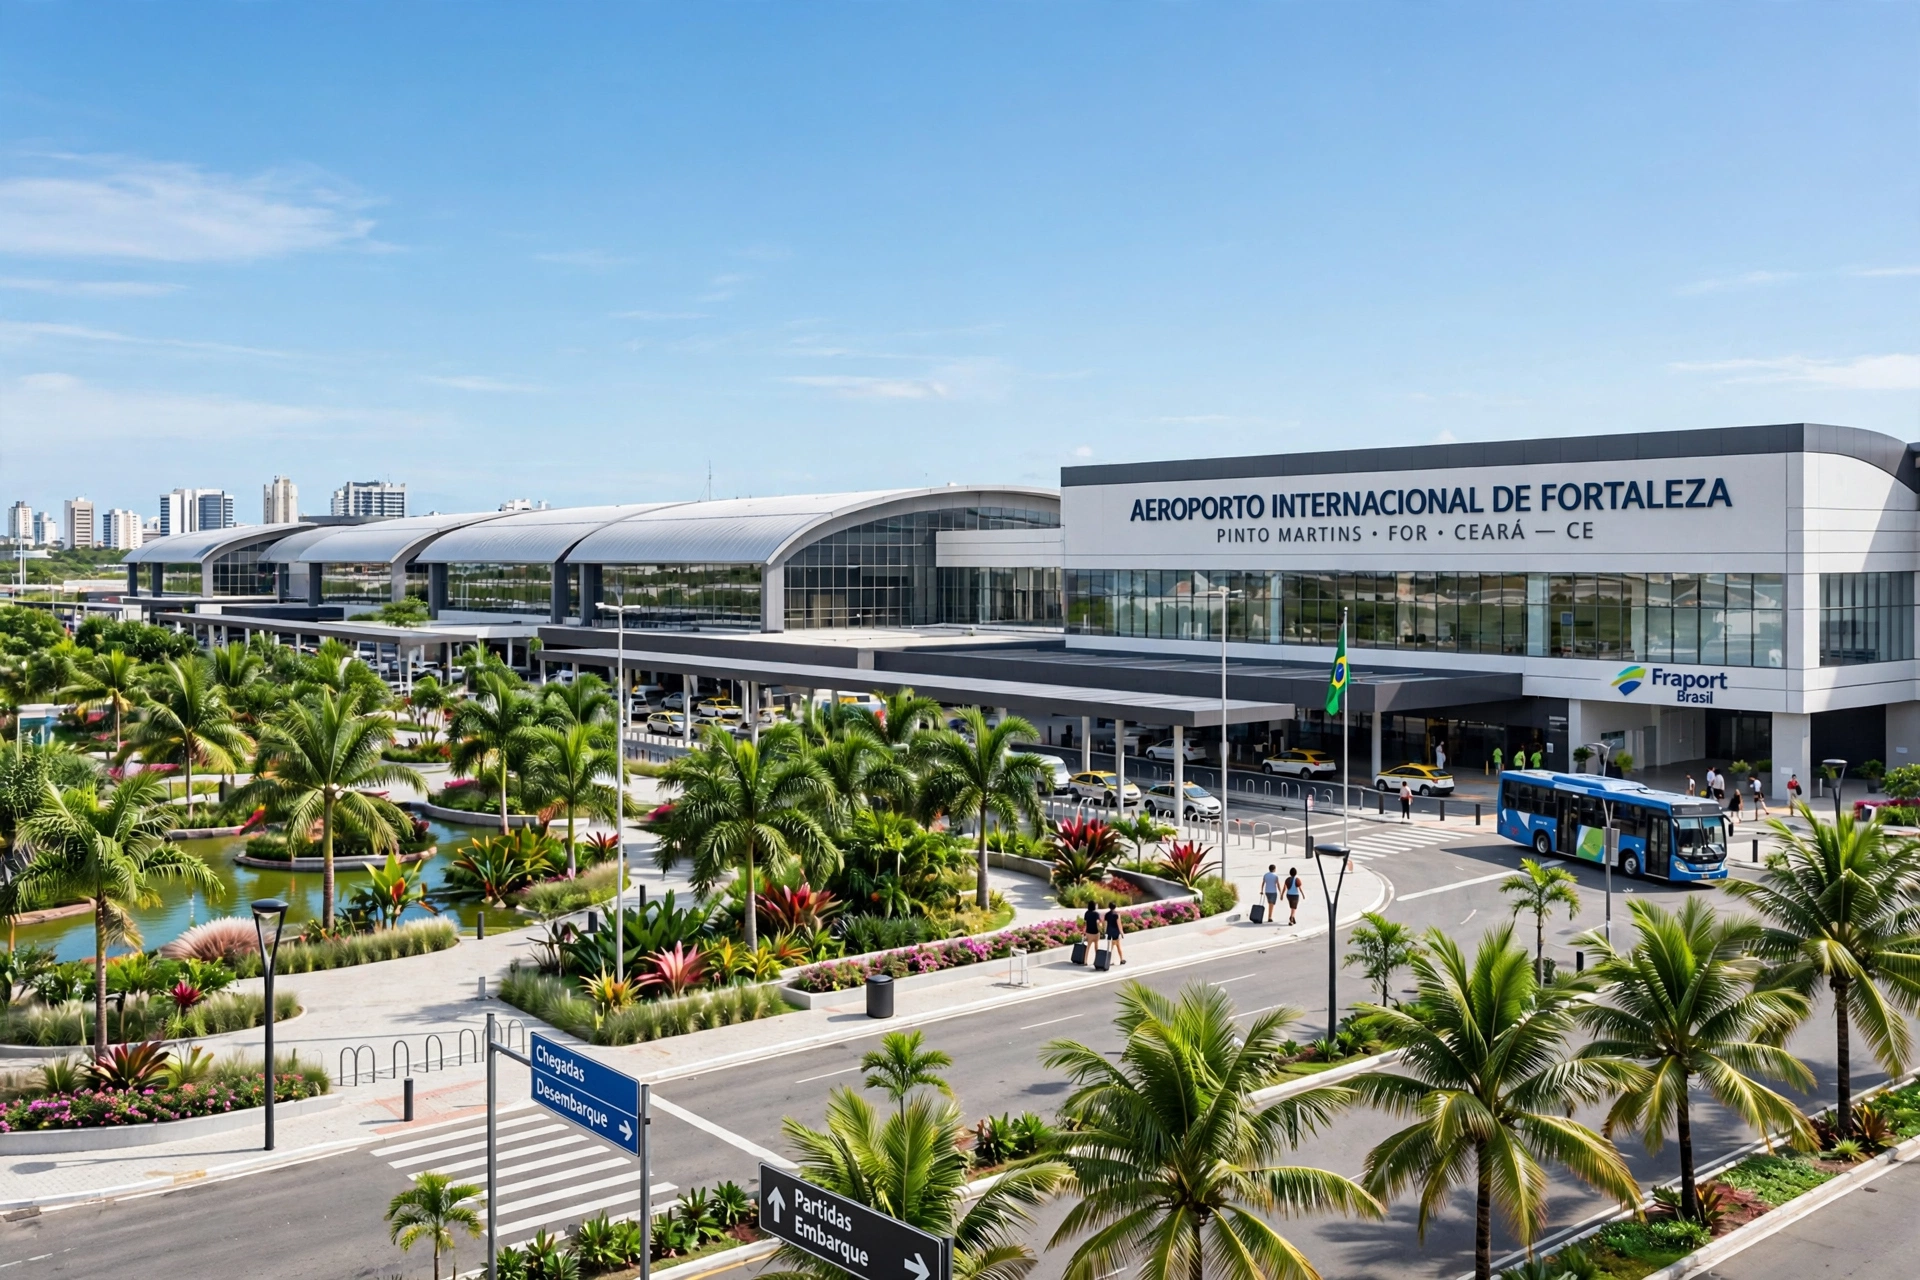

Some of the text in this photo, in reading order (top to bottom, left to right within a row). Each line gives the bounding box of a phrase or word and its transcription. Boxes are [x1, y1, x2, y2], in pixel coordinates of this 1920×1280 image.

[1129, 477, 1734, 523] AEROPORTO INTERNACIONAL DE FORTALEZA
[1217, 527, 1270, 544] PINTO
[1278, 525, 1362, 543] MARTINS
[1388, 524, 1428, 542] FOR
[1454, 518, 1526, 541] CEARÁ
[1566, 521, 1594, 540] CE
[1652, 667, 1729, 692] Fraport
[1676, 689, 1714, 704] Brasil
[536, 1044, 585, 1083] Chegadas
[536, 1077, 608, 1128] Desembarque
[794, 1188, 852, 1232] Partidas
[794, 1214, 869, 1267] Embarque
